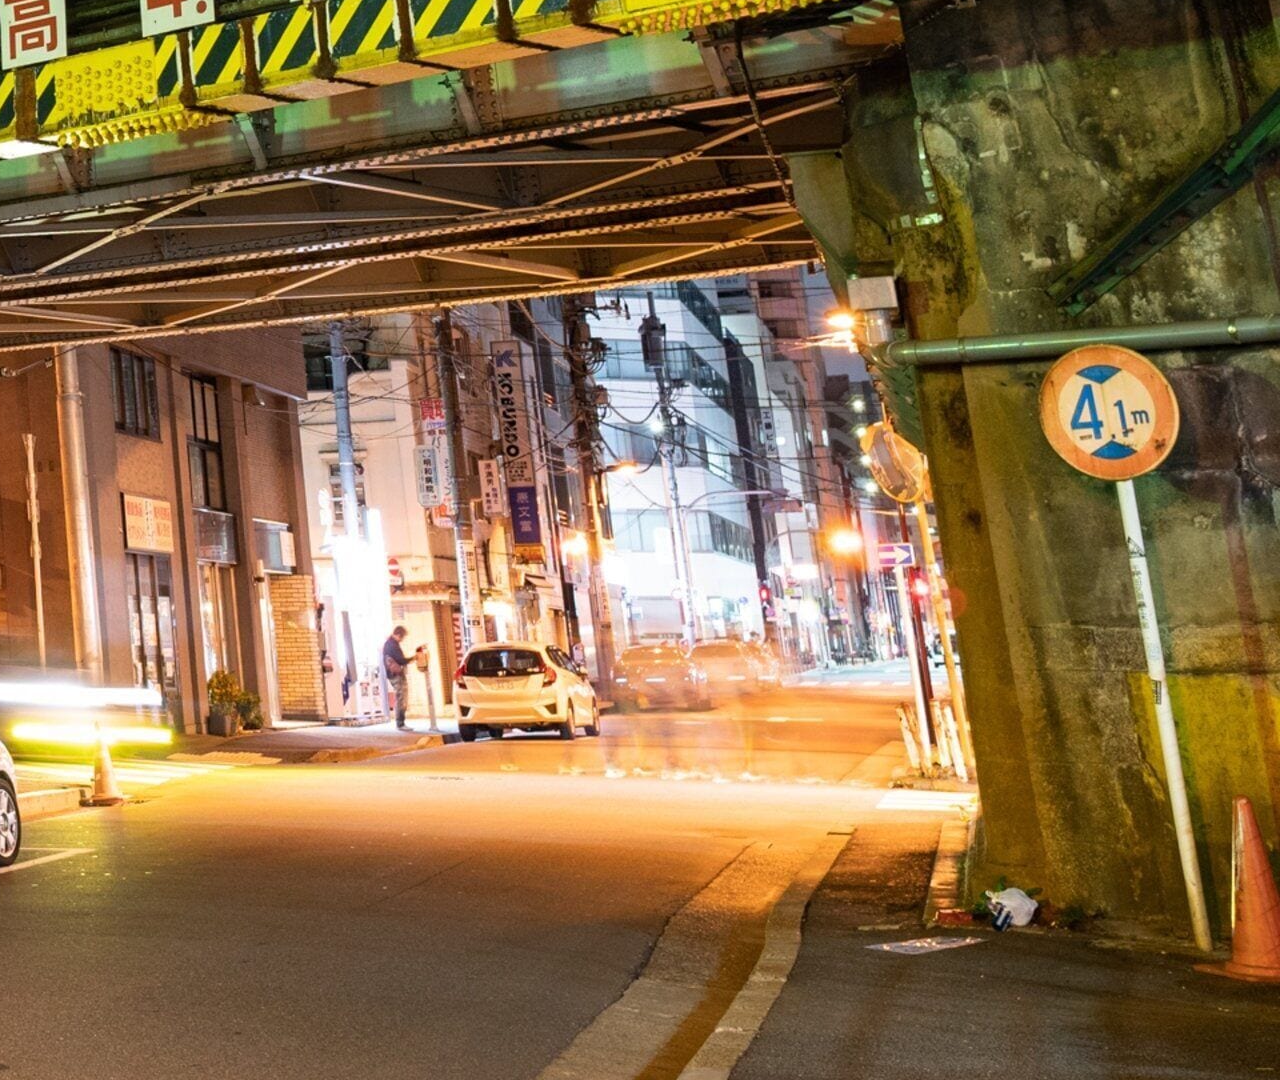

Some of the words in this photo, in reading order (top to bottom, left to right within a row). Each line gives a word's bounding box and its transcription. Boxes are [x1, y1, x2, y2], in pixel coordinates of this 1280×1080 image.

[498, 371, 520, 458] KOBUNDO
[423, 458, 435, 494] 明和病院
